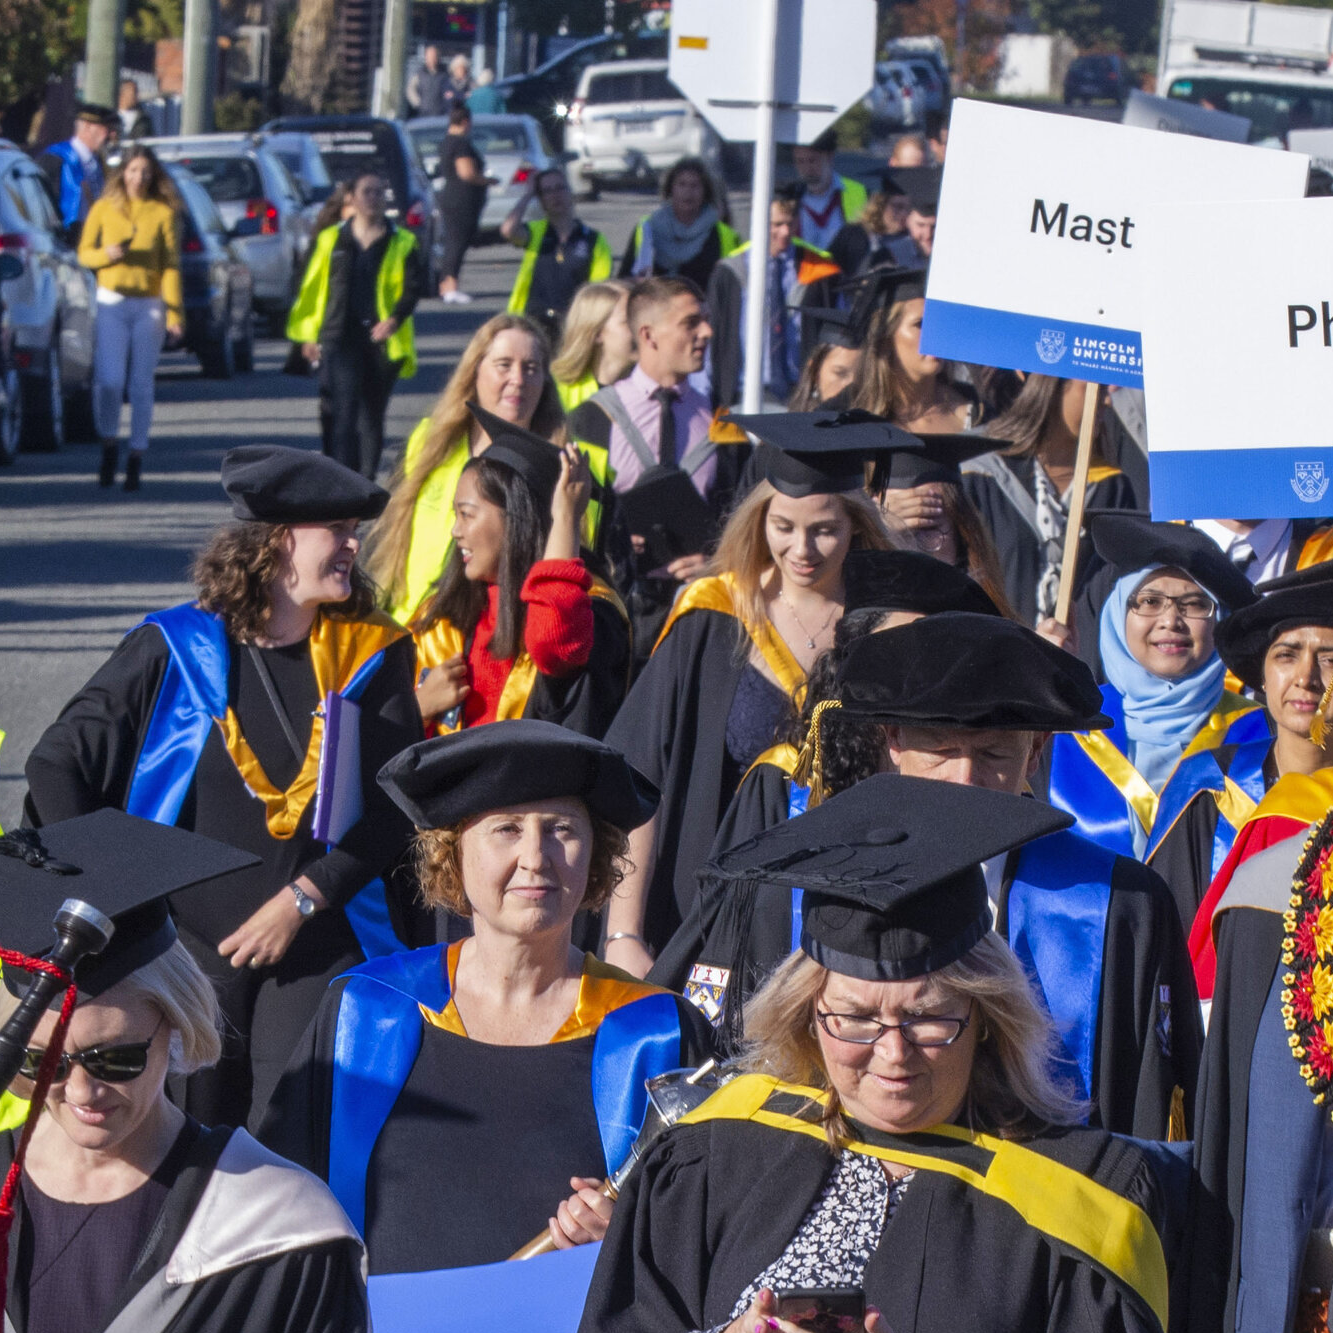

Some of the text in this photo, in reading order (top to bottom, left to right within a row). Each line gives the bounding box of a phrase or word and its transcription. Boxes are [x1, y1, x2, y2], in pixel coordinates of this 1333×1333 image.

[1030, 199, 1135, 249] Mast
[1074, 337, 1135, 354] LINCOLN
[1073, 348, 1142, 367] UNIVERSI
